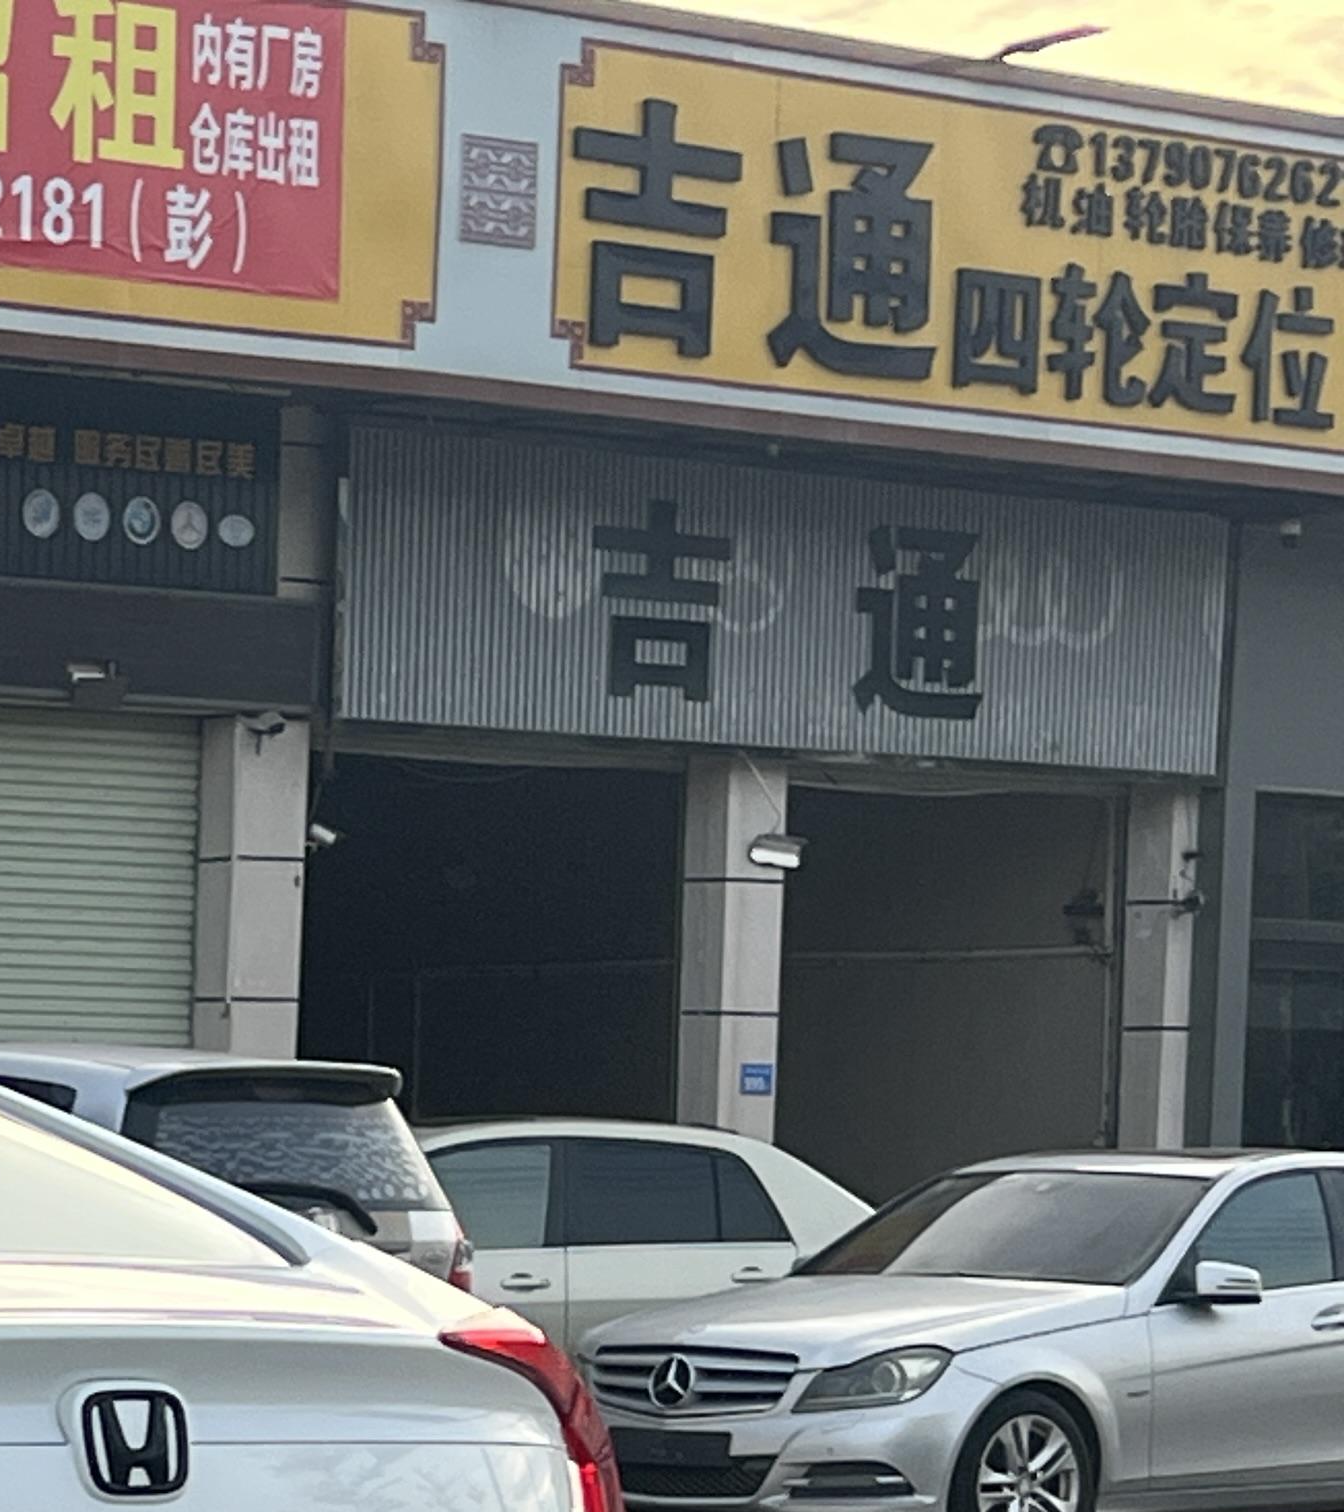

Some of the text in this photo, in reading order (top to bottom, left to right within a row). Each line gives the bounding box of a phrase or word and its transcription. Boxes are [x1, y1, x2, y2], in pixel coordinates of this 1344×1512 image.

[192, 15, 323, 100] 内有厂房
[189, 103, 320, 188] 仓库出租
[1089, 131, 1344, 207] 1379076262
[573, 98, 1335, 430] 吉通 四轮定位
[1020, 172, 1344, 269] 机油轮胎保养修
[592, 500, 983, 720] 吉通
